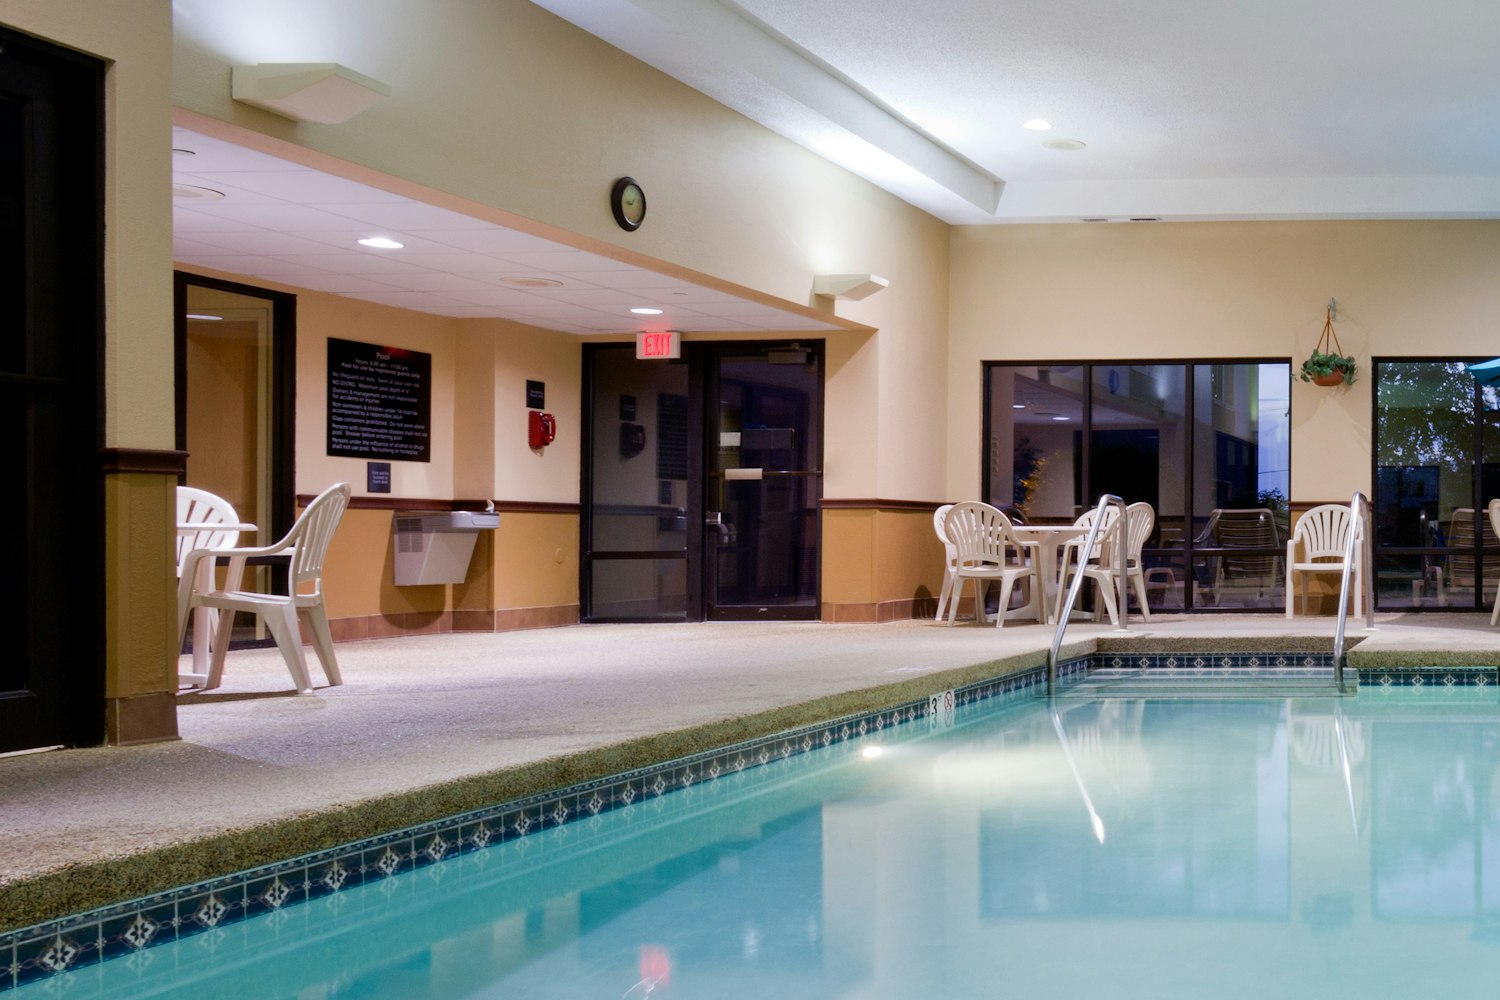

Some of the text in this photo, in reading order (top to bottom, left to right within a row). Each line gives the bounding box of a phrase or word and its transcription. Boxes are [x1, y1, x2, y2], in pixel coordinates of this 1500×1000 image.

[643, 333, 672, 356] EXIT
[376, 352, 390, 361] Pool
[931, 697, 938, 715] 3
